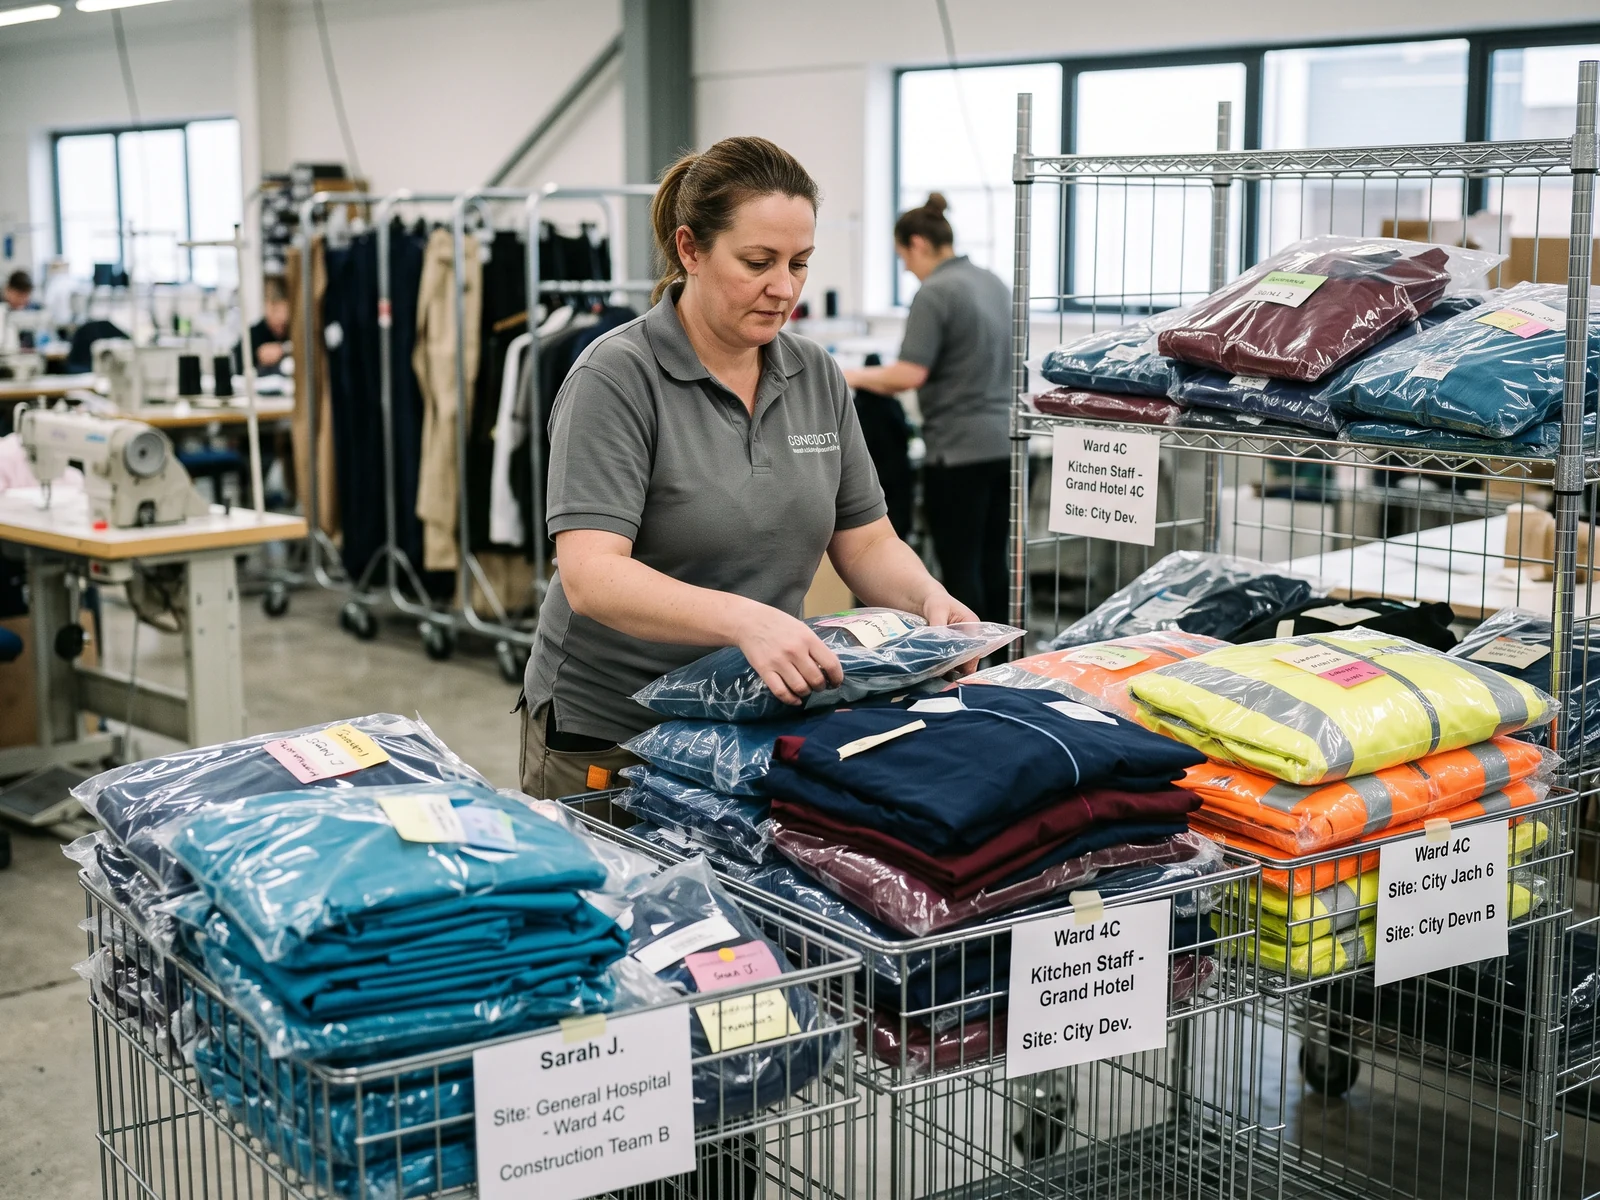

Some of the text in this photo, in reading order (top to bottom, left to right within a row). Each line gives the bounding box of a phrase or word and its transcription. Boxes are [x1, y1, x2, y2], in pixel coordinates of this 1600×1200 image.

[1083, 439, 1127, 455] Ward 4C
[1068, 460, 1107, 476] Kitchen
[1110, 465, 1135, 479] Staff
[1066, 477, 1144, 498] Grand Hotel 4C
[1065, 503, 1137, 524] Site: City Dev.
[1415, 837, 1470, 863] Ward 4C
[1388, 862, 1494, 899] Site: City Jach 6
[1054, 920, 1121, 947] Ward 4C
[1385, 903, 1495, 943] Site: City Devn B
[1031, 961, 1091, 984] Kitchen
[1096, 949, 1134, 972] Staff
[1040, 974, 1134, 1007] Grand Hotel
[1022, 1017, 1132, 1050] Site: City Dev.
[540, 1036, 625, 1070] Sarah J.
[493, 1071, 671, 1127] Site: General Hospital
[554, 1111, 597, 1136] Ward
[602, 1105, 625, 1124] 4C
[499, 1126, 670, 1182] Construction Team B
